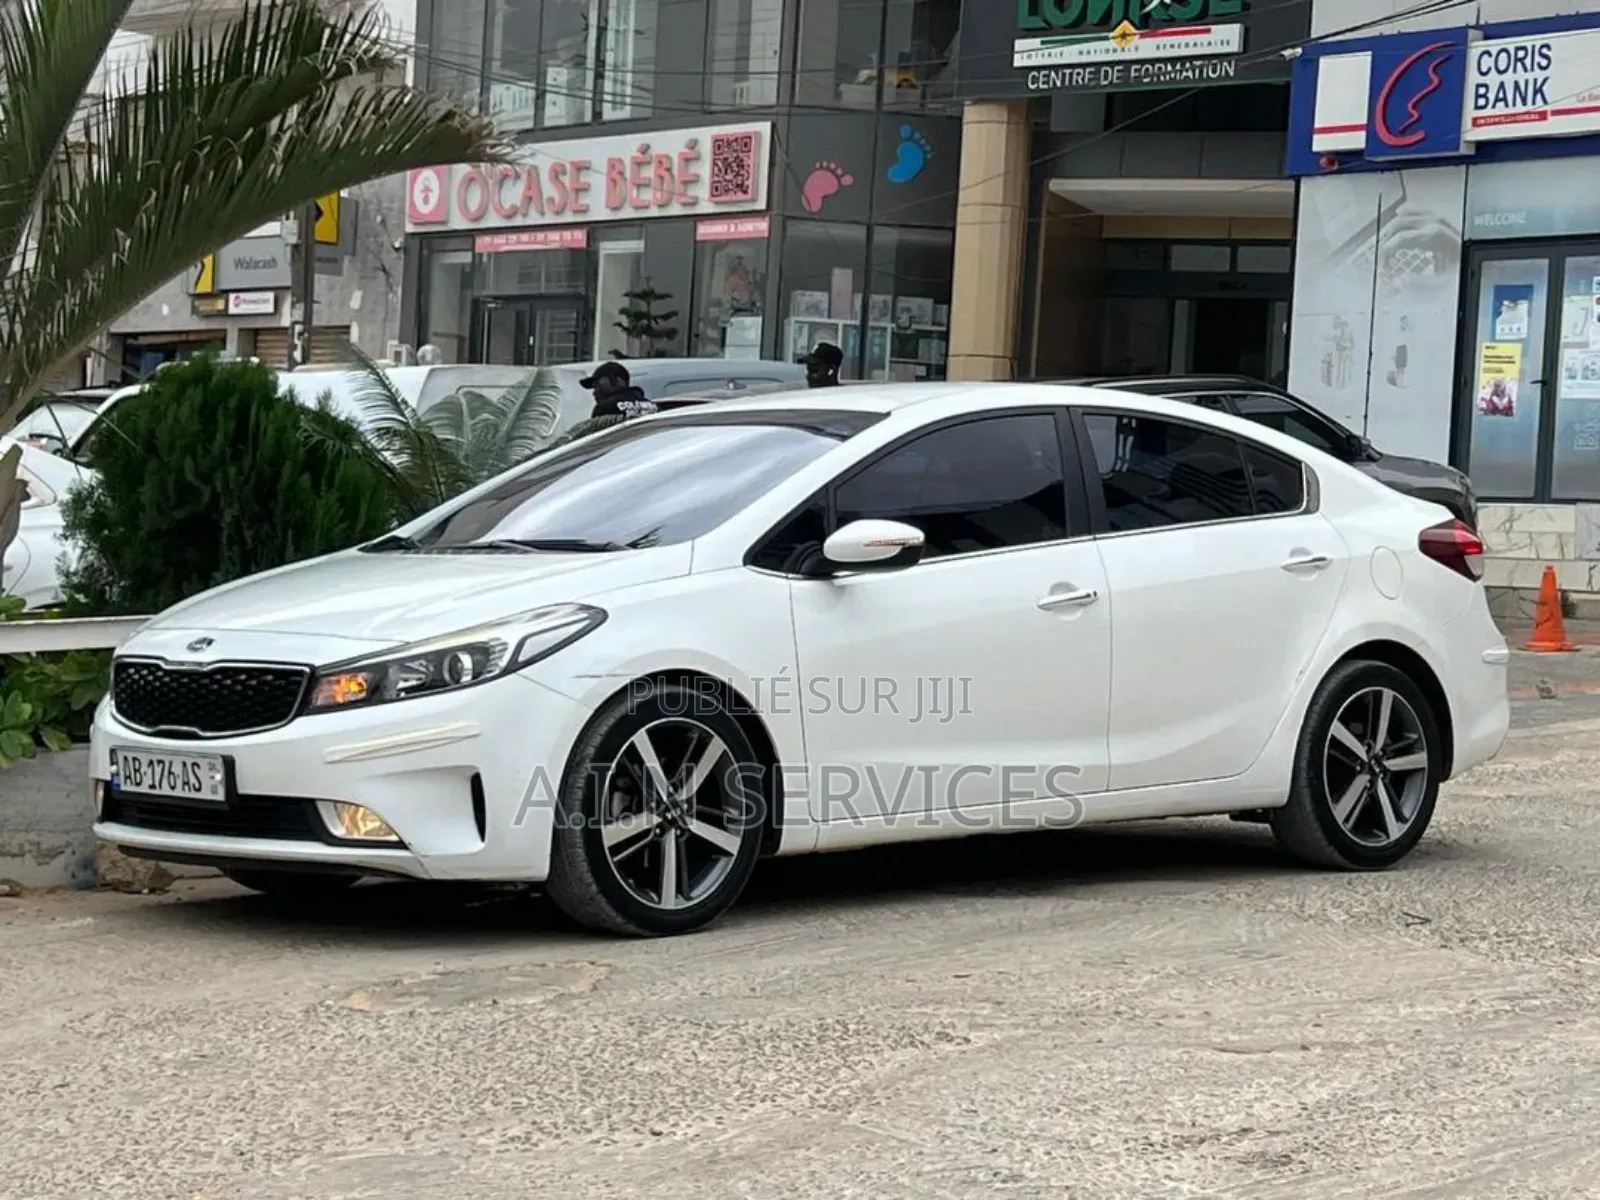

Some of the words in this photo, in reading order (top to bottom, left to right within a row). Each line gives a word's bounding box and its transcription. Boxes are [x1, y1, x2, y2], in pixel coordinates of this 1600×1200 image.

[1027, 67, 1096, 90] CENTRE
[1100, 66, 1124, 86] DE
[1130, 59, 1236, 83] FORMATION
[1477, 43, 1552, 77] CORIS
[1474, 76, 1550, 110] BANK
[605, 138, 702, 211] BÉBÉ
